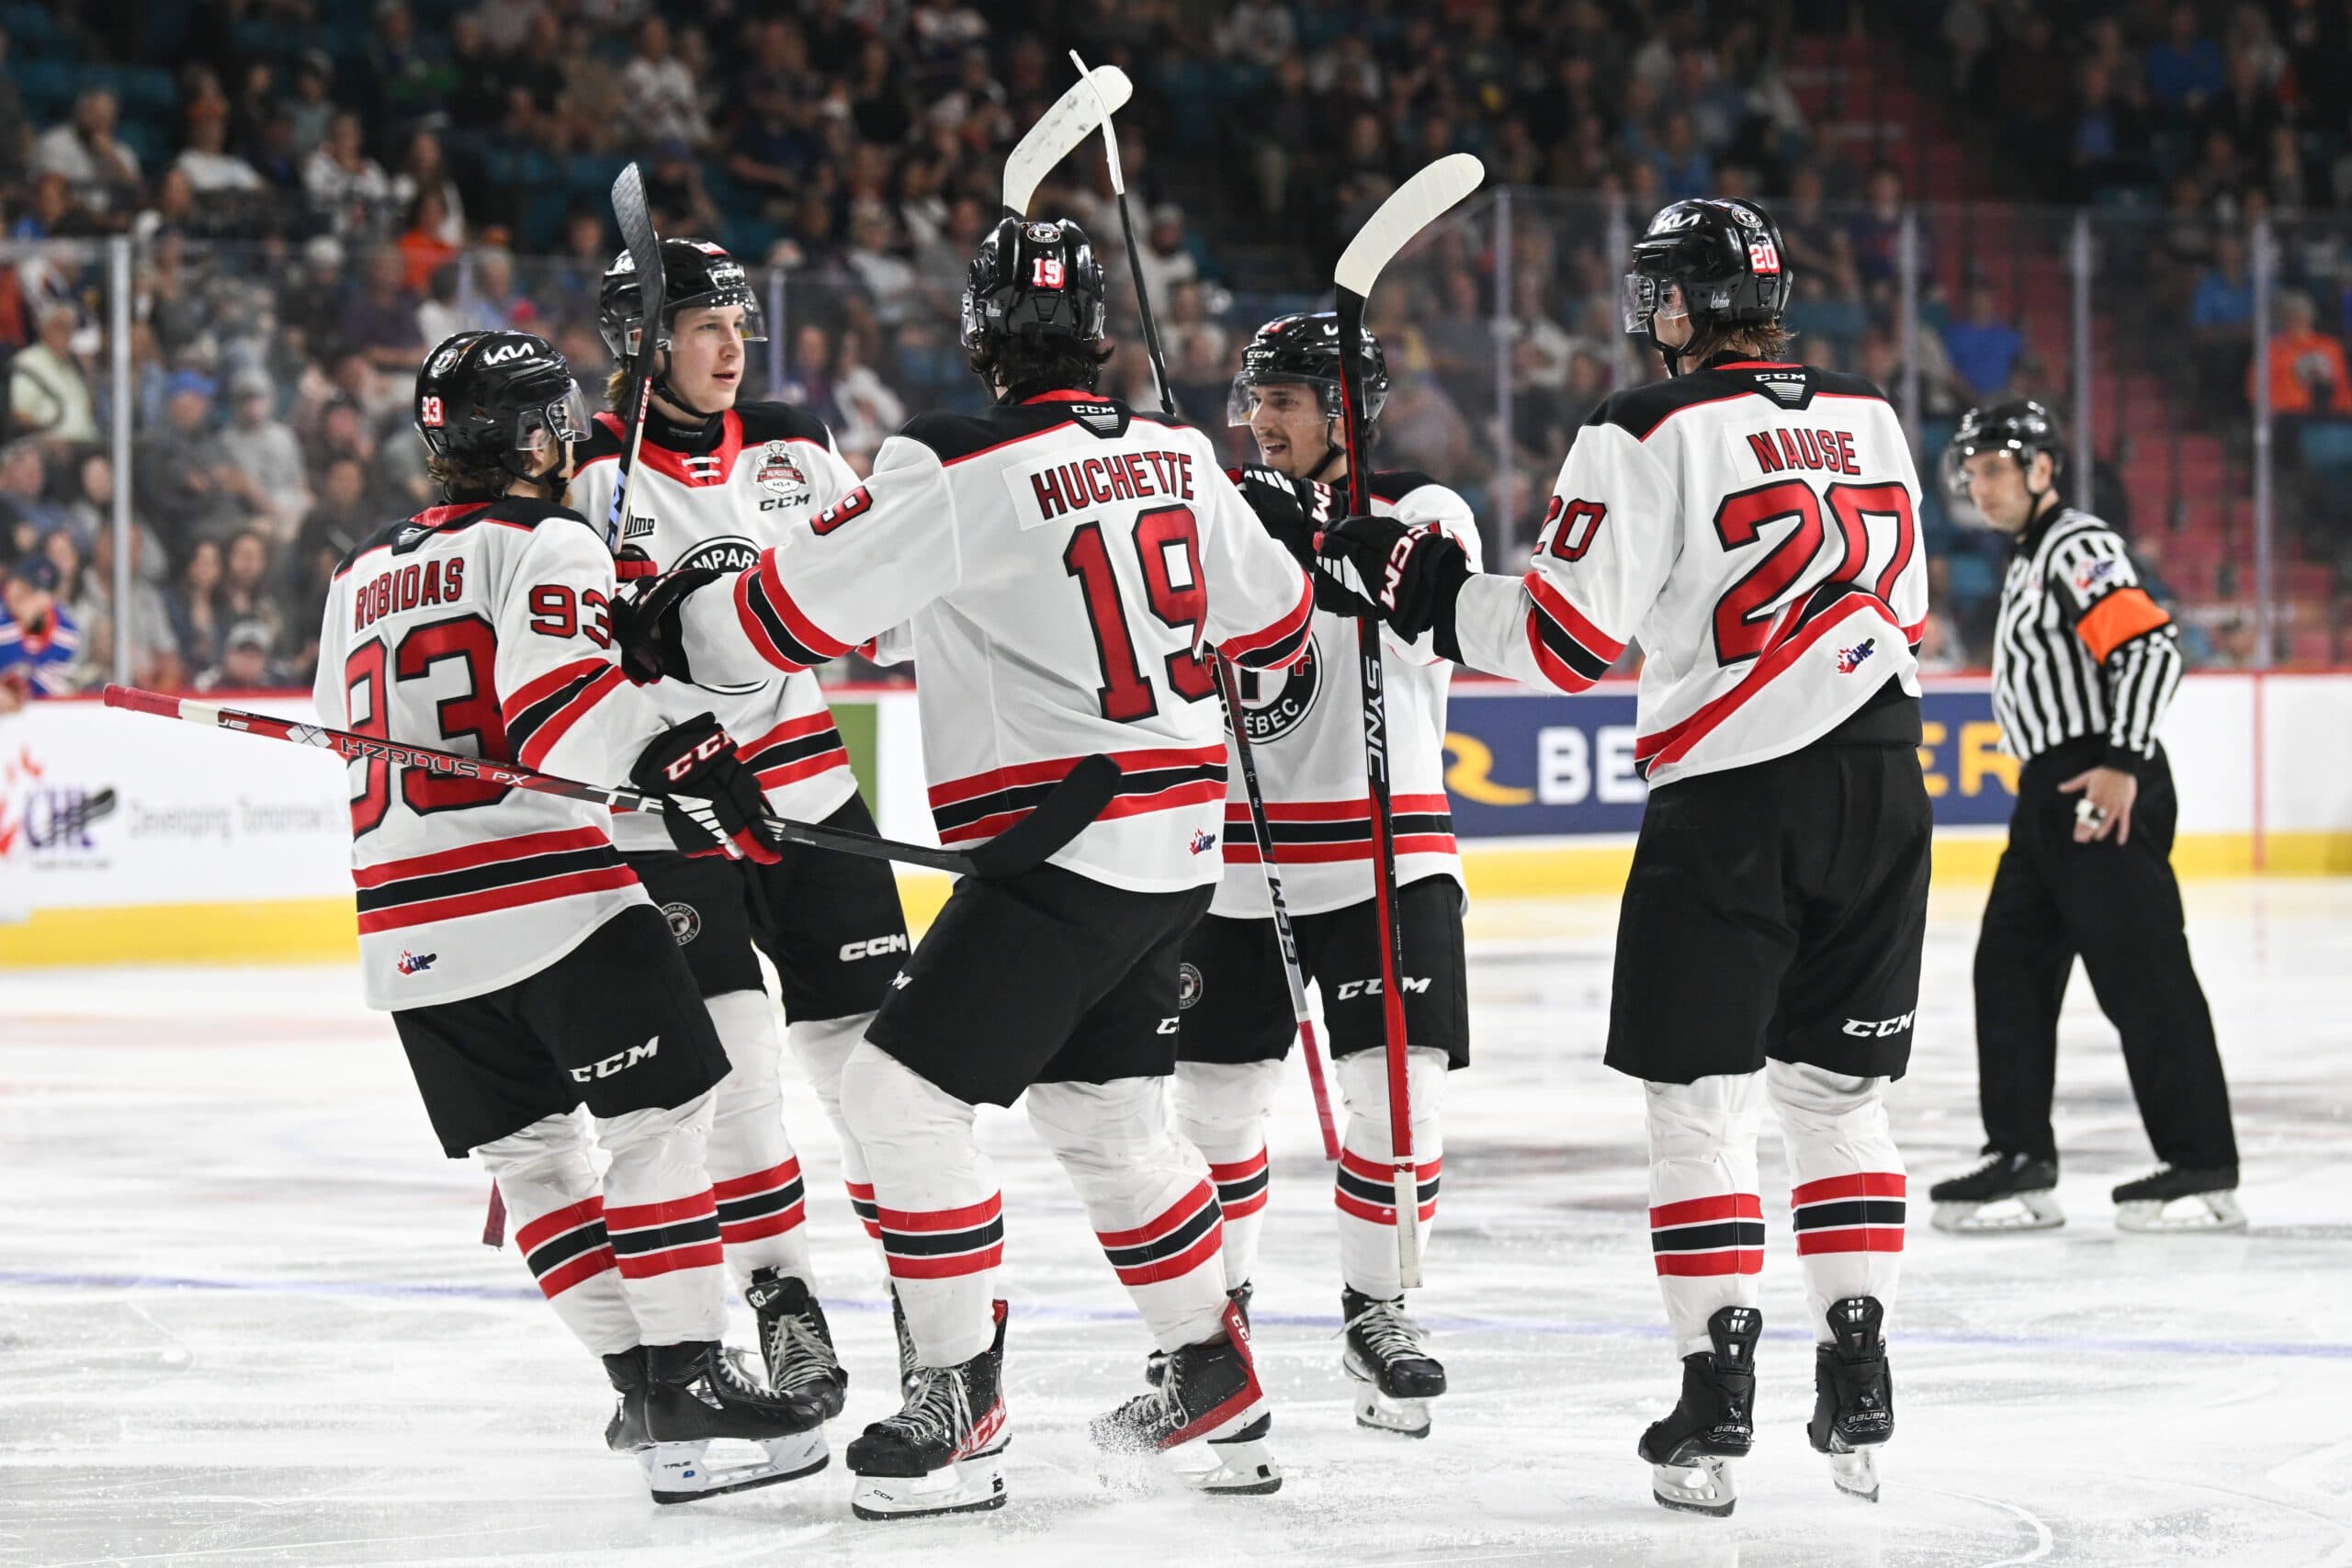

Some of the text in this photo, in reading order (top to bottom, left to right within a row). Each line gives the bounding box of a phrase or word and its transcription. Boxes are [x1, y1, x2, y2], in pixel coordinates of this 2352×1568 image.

[1033, 257, 1065, 288] 19
[1748, 243, 1780, 274] 20
[1247, 351, 1275, 359] CCM
[1754, 373, 1806, 382] CCM
[421, 396, 444, 426] 93
[1071, 404, 1115, 414] CCM
[1747, 428, 1861, 476] NAUSE
[759, 493, 810, 512] CCM
[1030, 450, 1194, 521] HUCHETTE
[1532, 495, 1607, 562] 20
[1712, 478, 1916, 668] 20
[354, 557, 464, 632] ROBIDAS
[1062, 503, 1218, 724] 19
[529, 584, 613, 649] 93
[345, 613, 505, 842] 93
[1364, 654, 1385, 784] SYNC
[341, 738, 480, 780] HZRDUS
[492, 770, 530, 786] PX
[1269, 878, 1298, 966] CCM
[840, 934, 908, 962] CCM
[1841, 1010, 1916, 1037] CCM
[568, 1044, 660, 1082] CCM
[662, 1461, 692, 1470] TRUE
[873, 1489, 894, 1501] CCM
